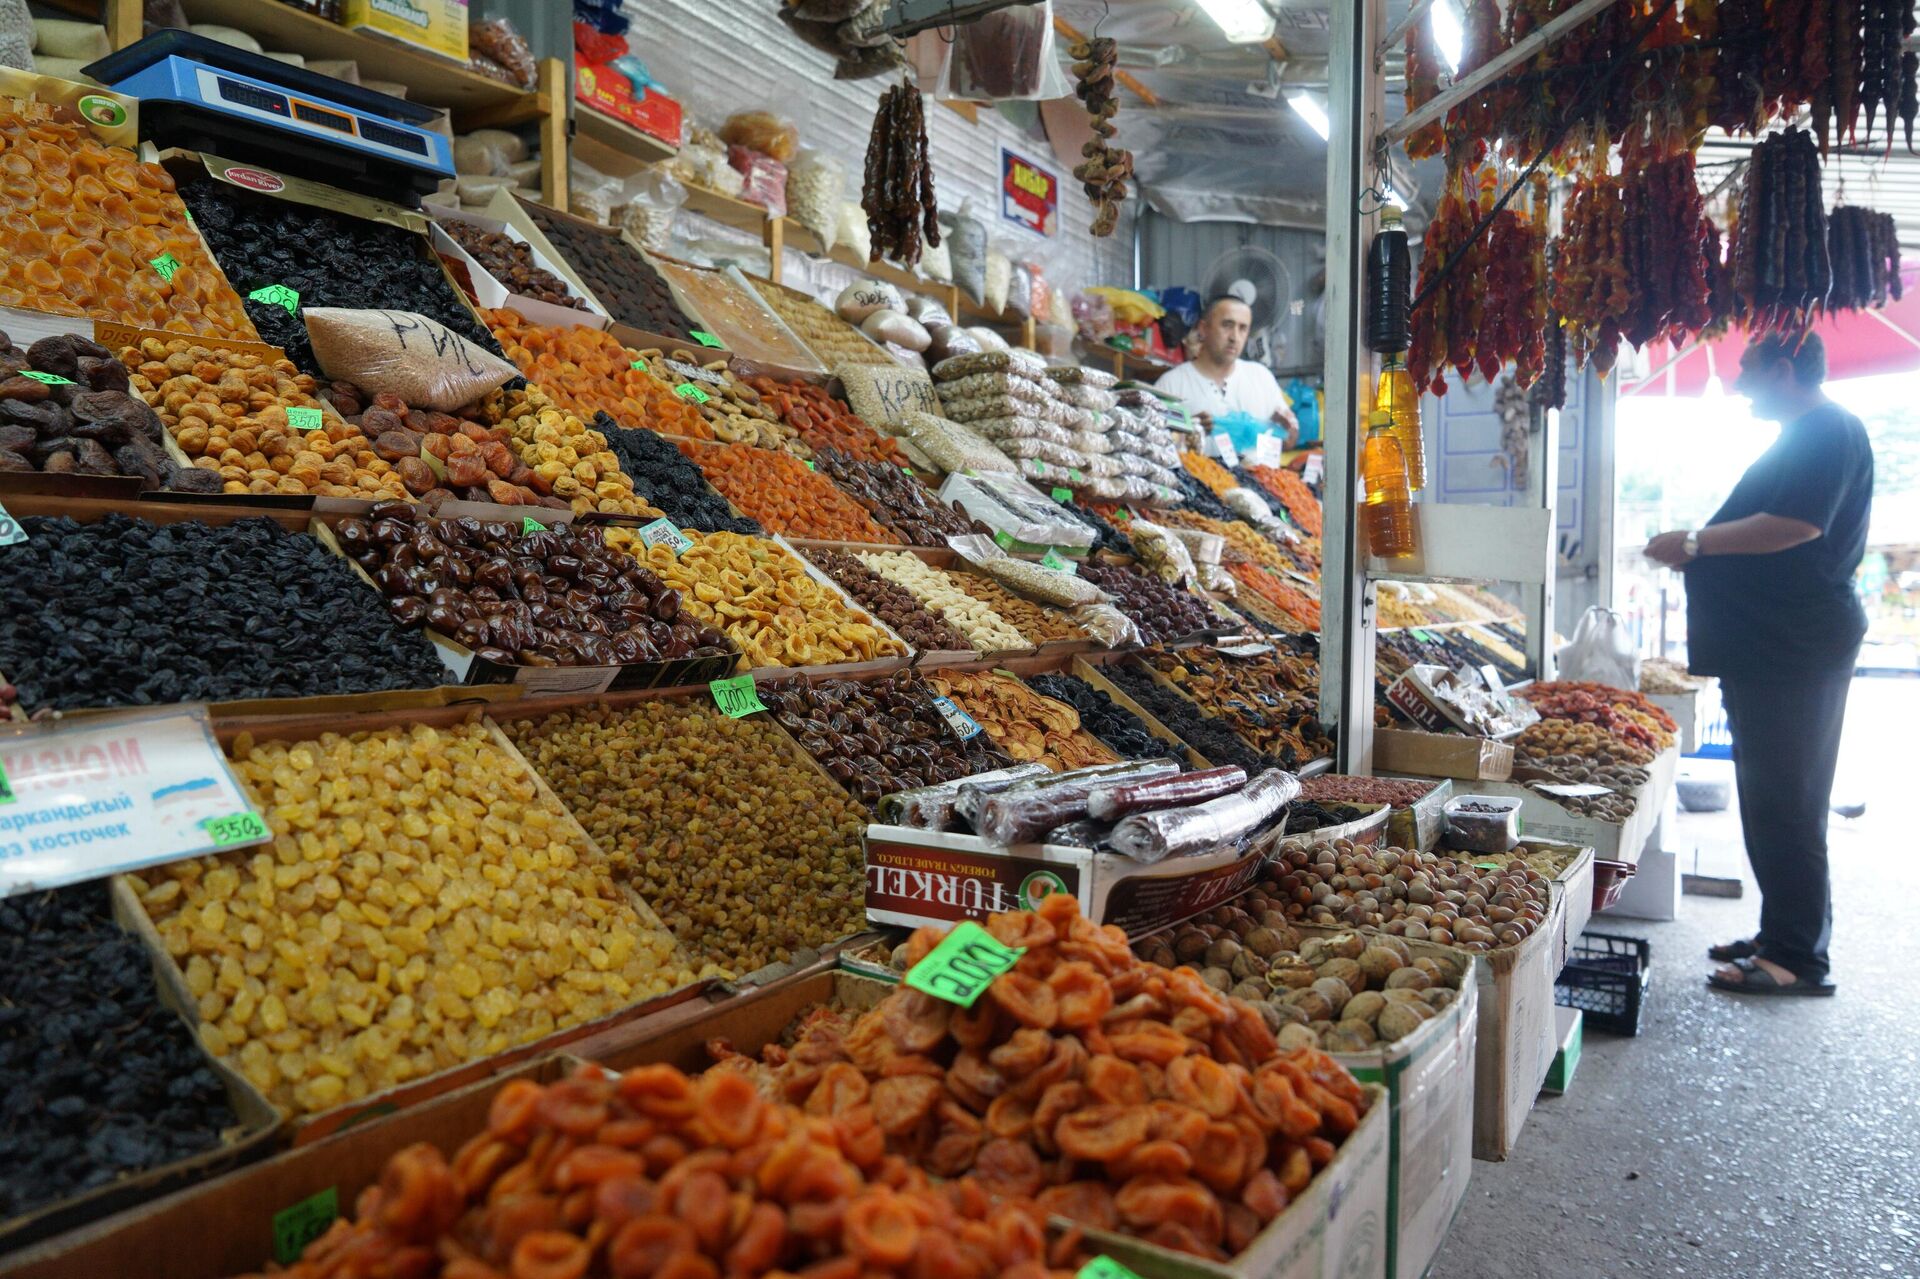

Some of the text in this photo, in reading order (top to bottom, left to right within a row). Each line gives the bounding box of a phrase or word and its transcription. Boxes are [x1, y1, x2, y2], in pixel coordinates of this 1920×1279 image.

[228, 169, 282, 191] Jordan River
[29, 823, 131, 853] косточек
[919, 858, 950, 872] TRADE
[950, 863, 996, 878] FOREIGN
[866, 864, 1009, 917] TÜRKEL
